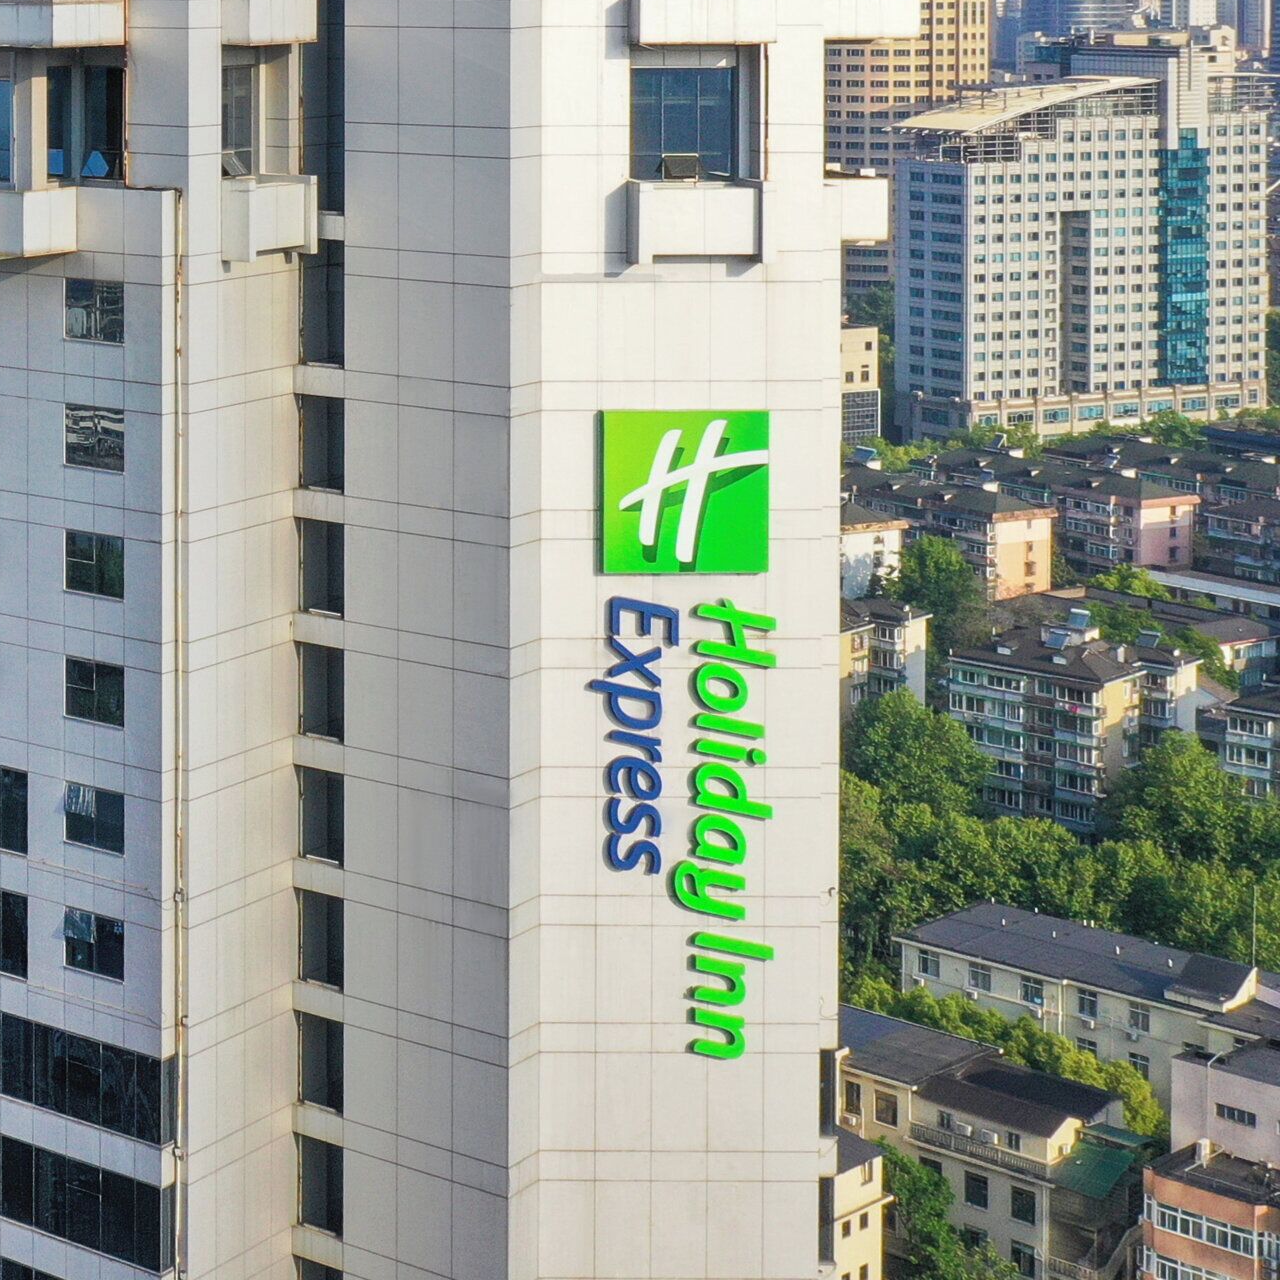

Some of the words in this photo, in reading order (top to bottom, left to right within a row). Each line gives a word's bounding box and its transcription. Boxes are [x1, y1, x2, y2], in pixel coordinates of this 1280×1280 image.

[590, 596, 680, 875] Express
[675, 598, 776, 920] Holiday
[692, 931, 774, 1060] Inn
